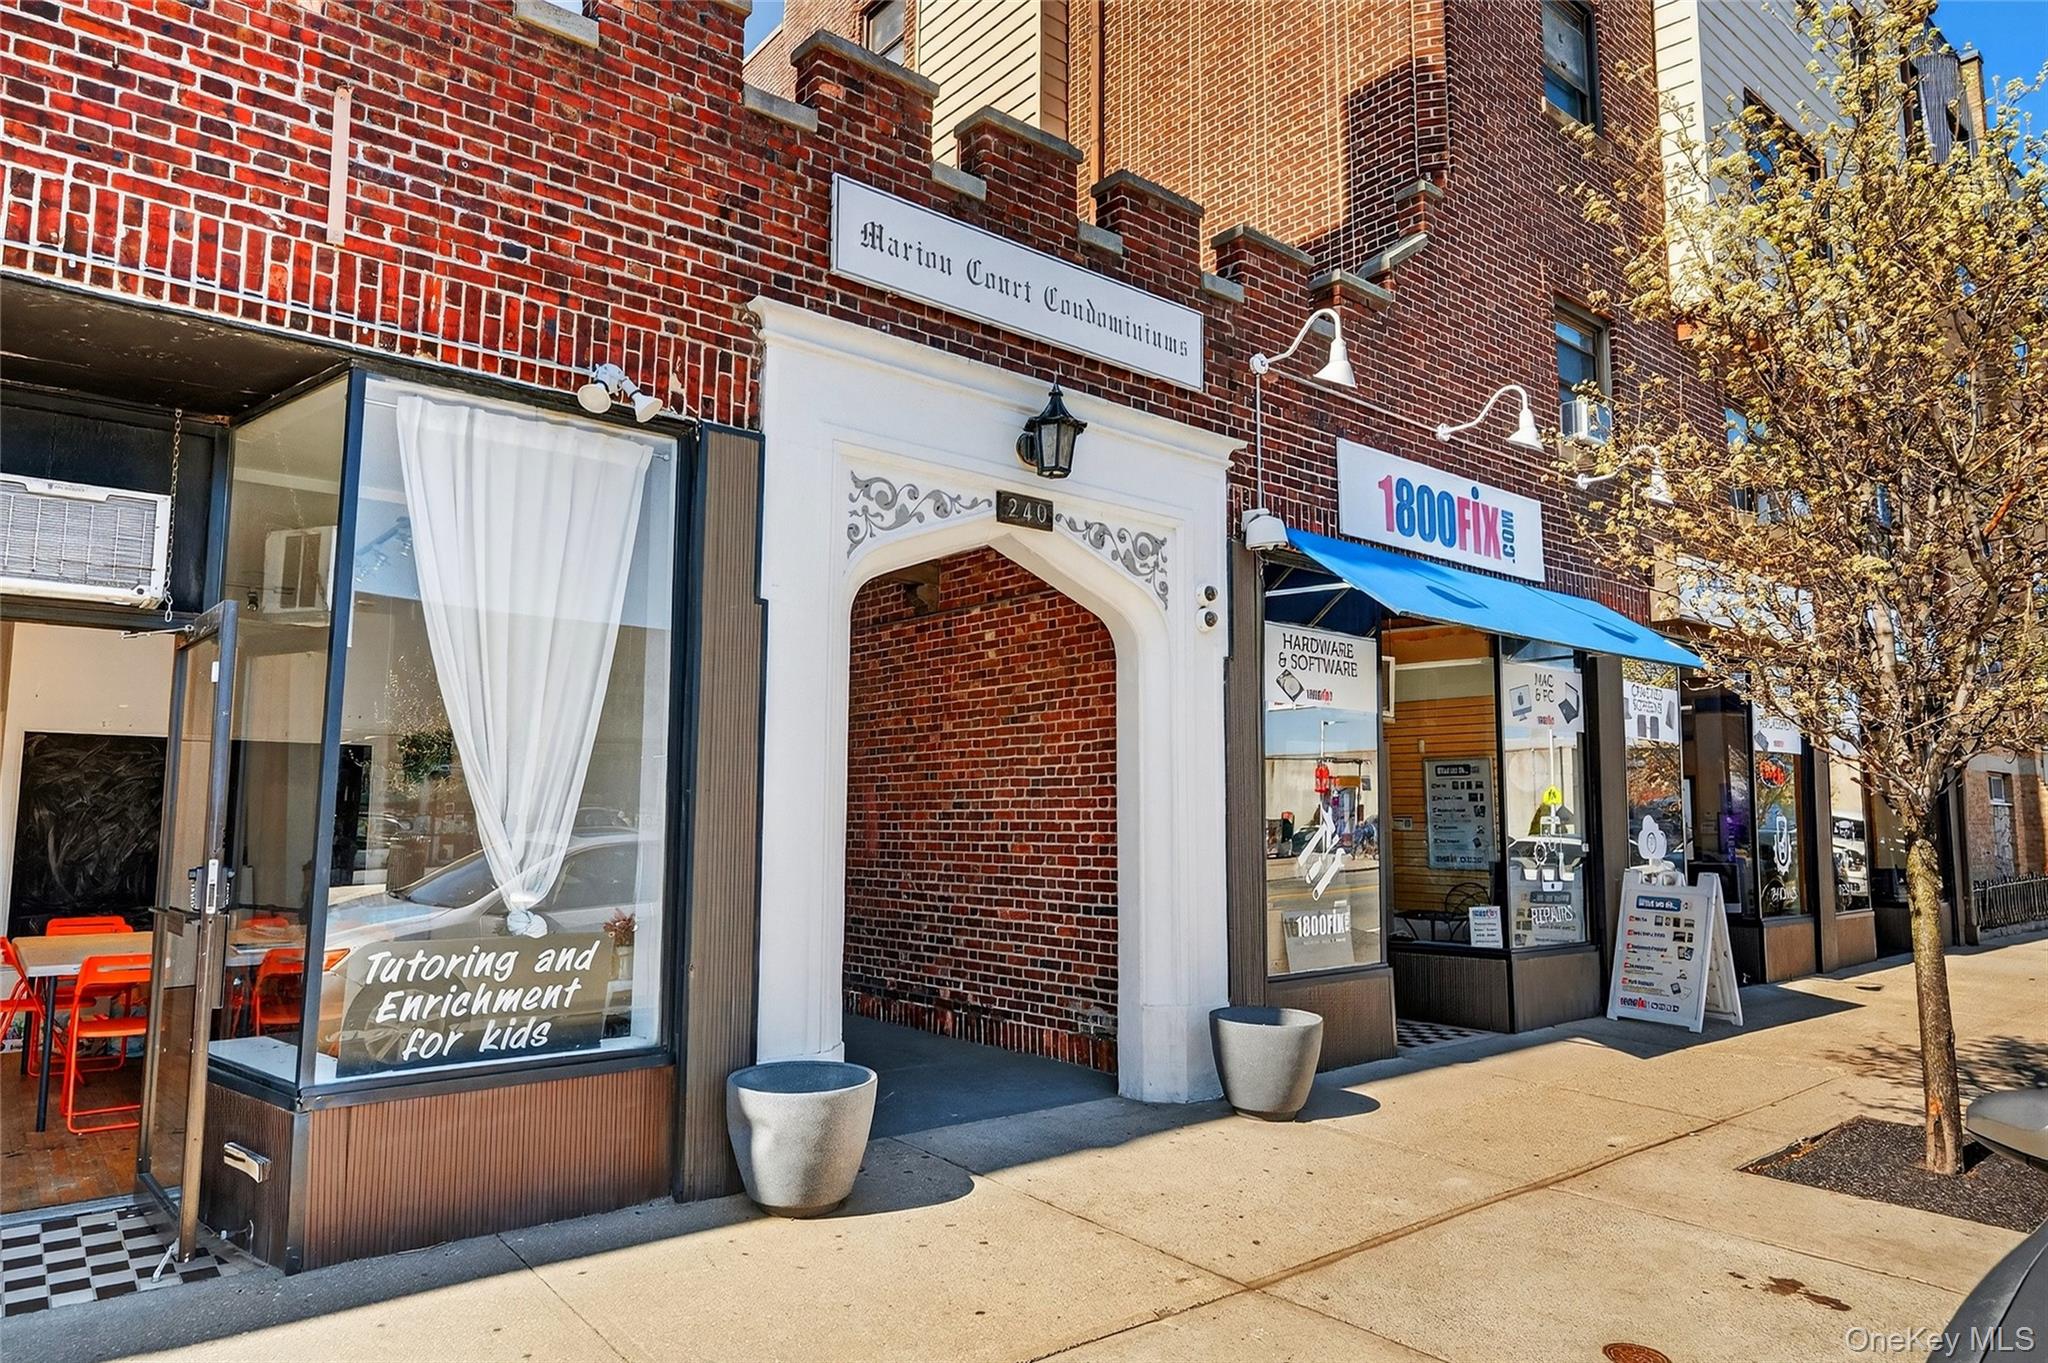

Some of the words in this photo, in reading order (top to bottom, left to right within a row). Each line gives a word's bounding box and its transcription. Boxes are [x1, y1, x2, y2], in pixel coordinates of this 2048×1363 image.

[860, 220, 952, 276] Marion
[966, 257, 1033, 304] Court
[1043, 285, 1189, 357] Condominiums
[1007, 497, 1047, 524] 240
[1278, 651, 1287, 668] &
[1290, 653, 1358, 678] SOFTWARE
[1282, 632, 1354, 659] HARDWARE
[365, 943, 520, 986] Tutoring
[533, 940, 600, 973] and
[375, 978, 582, 1025] Enrichment
[401, 1028, 464, 1062] for
[478, 1016, 550, 1053] kids
